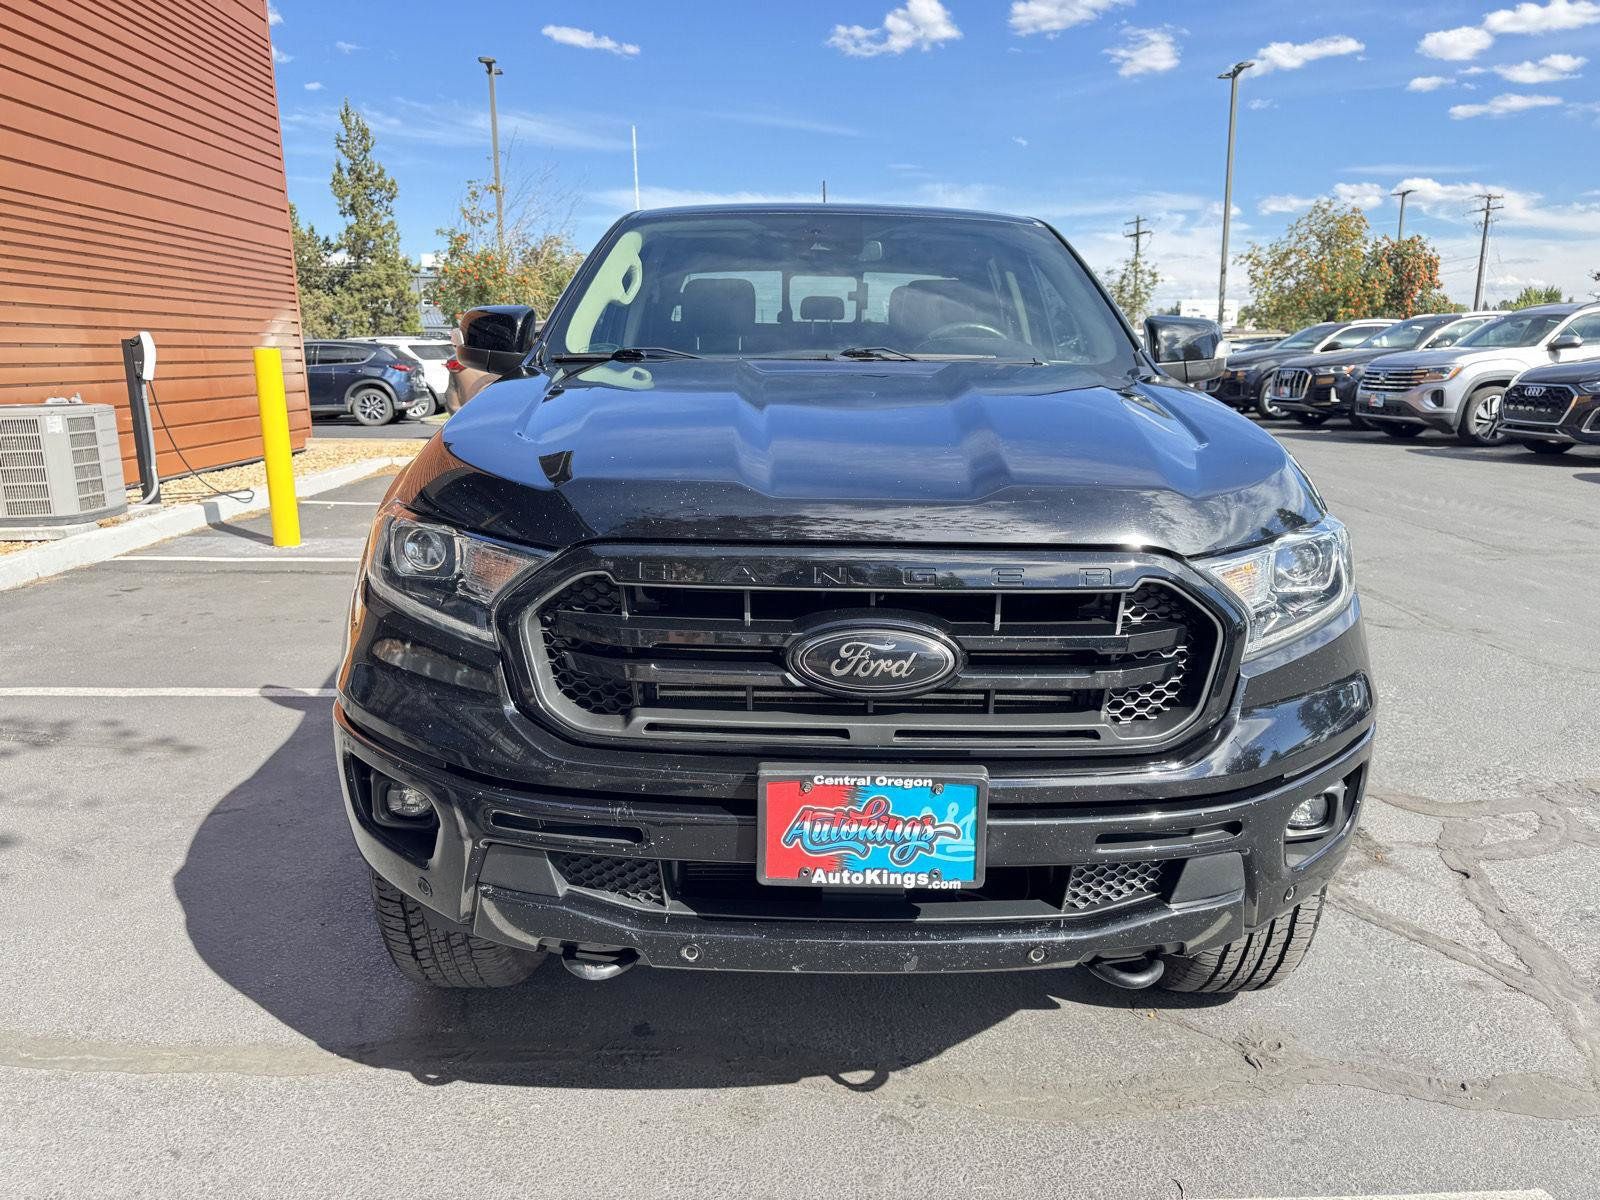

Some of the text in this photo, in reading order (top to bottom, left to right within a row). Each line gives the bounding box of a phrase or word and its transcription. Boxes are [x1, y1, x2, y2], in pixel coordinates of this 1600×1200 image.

[830, 640, 918, 679] Ford
[813, 775, 933, 789] Central Oregon
[811, 869, 962, 890] AutoKings.com
